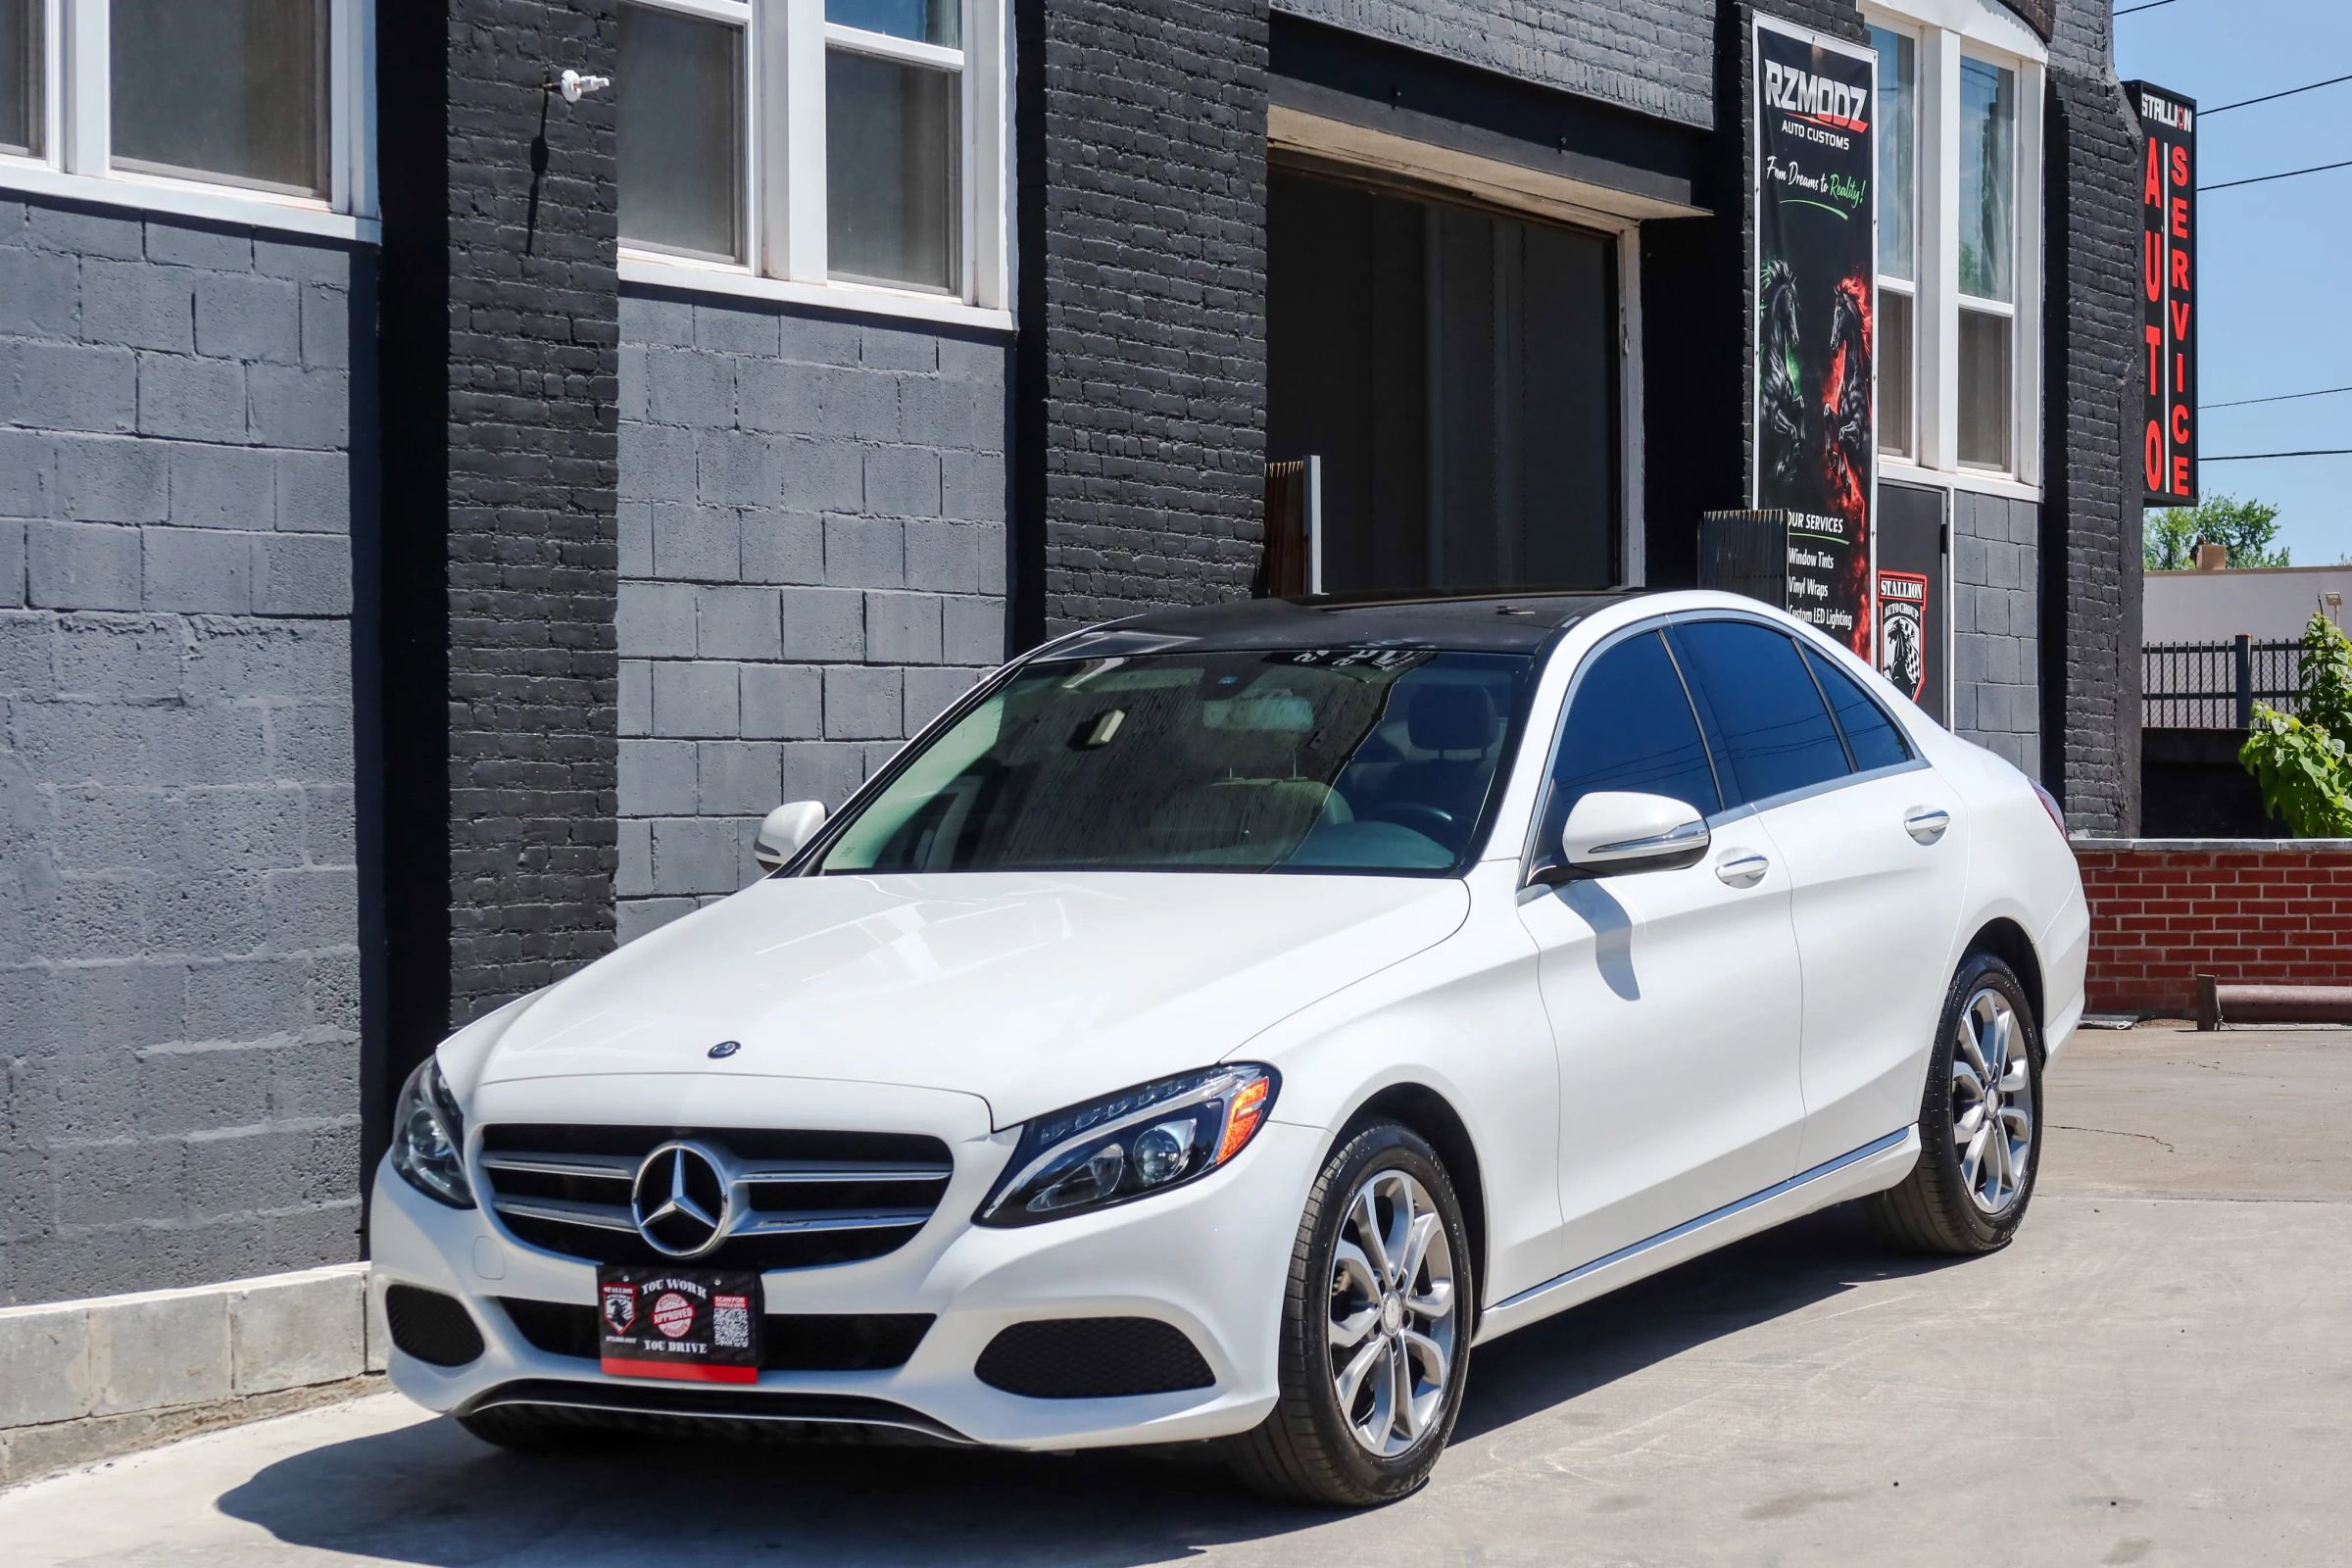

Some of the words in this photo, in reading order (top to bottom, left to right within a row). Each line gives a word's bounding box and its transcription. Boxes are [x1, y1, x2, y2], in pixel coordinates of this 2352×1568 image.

[1764, 58, 1869, 133] RZMODZ
[2141, 92, 2192, 132] STALLION
[1782, 119, 1805, 138] AUTO
[1807, 126, 1850, 151] CUSTOMS
[1767, 155, 1788, 181] From
[1788, 161, 1819, 191] Dreams
[1820, 172, 1829, 193] to
[1830, 173, 1867, 209] Reality!
[2144, 136, 2162, 491] AUTO
[2171, 144, 2189, 497] SERVICE
[1805, 514, 1843, 534] SERVICES
[1788, 547, 1817, 566] Window
[1818, 551, 1835, 569] Tints
[1788, 576, 1806, 599] Vinyl
[1807, 578, 1829, 602] Wraps
[1881, 579, 1924, 600] STALLION
[1813, 608, 1826, 624] LED
[1826, 609, 1852, 631] Lighting
[1884, 602, 1899, 619] AUTO
[1899, 602, 1920, 621] GROUP
[641, 1279, 664, 1296] YOU
[665, 1278, 707, 1300] WORK
[644, 1340, 666, 1351] YOU
[667, 1342, 708, 1353] DRIVE
